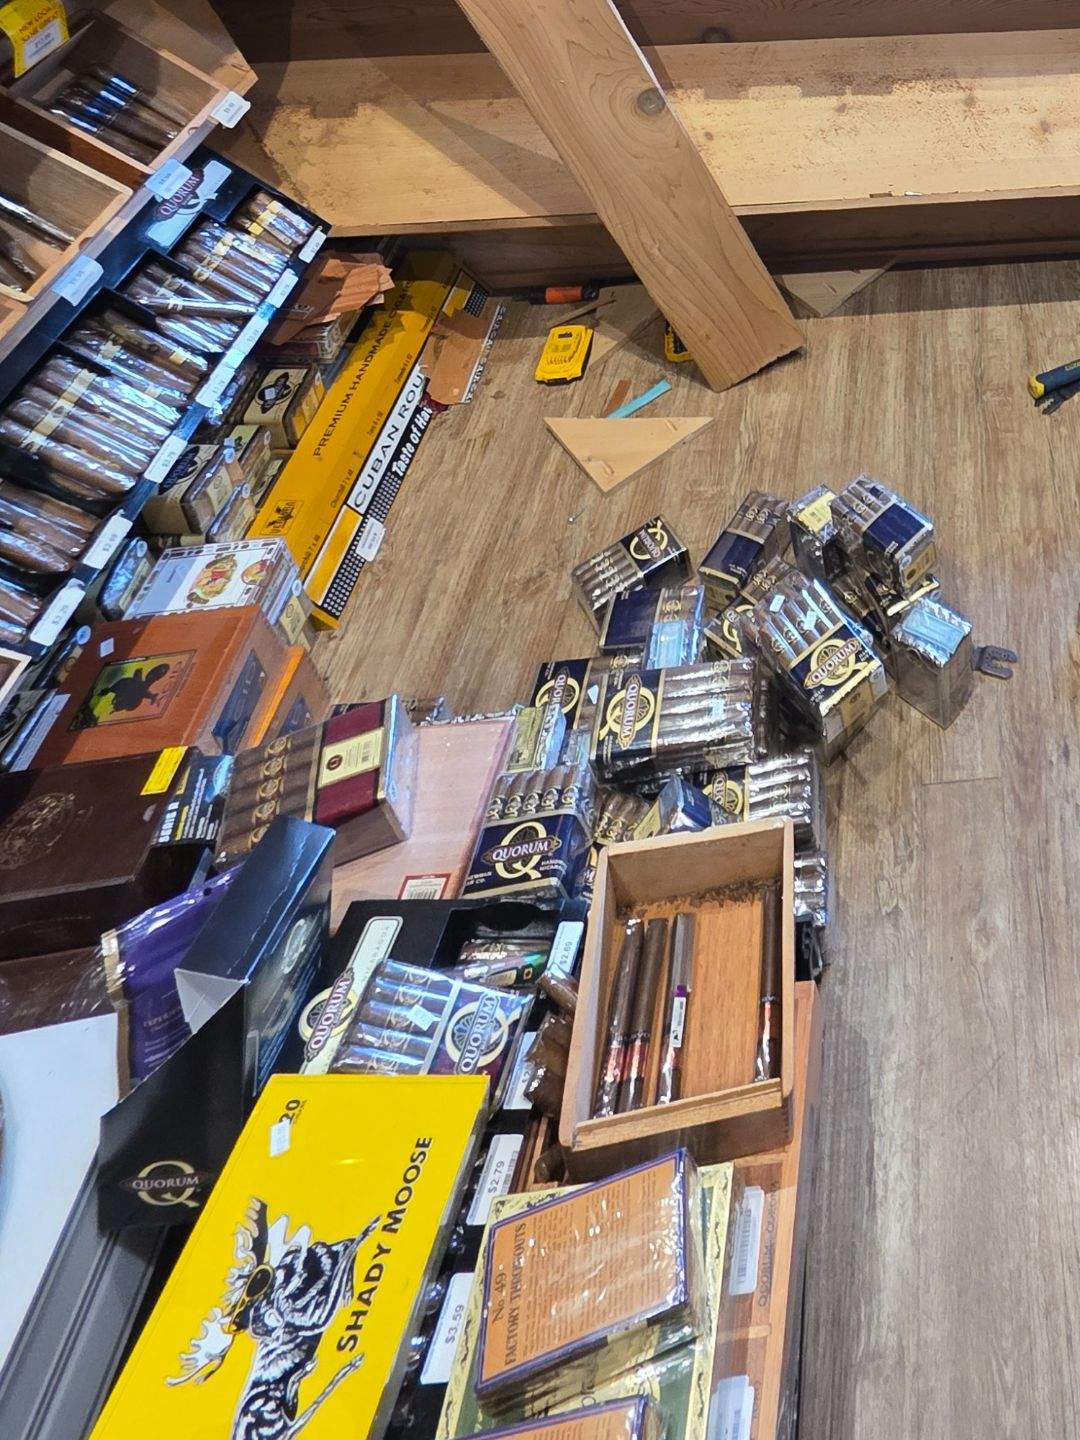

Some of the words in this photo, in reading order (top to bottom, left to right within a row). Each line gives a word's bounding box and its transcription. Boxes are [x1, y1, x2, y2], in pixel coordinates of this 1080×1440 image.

[160, 175, 202, 218] QUORUM
[313, 391, 352, 458] PREMIUM
[349, 317, 396, 392] HANDMADE
[353, 426, 400, 508] CUBAN
[396, 372, 427, 419] ROU
[392, 440, 415, 478] Taste
[811, 640, 858, 684] QUORUM
[620, 682, 641, 740] QUORUM
[492, 840, 550, 862] QUORUM
[310, 978, 351, 1050] QUORUM
[460, 993, 498, 1073] QUORUM
[131, 1173, 200, 1193] QUORUM
[487, 1160, 506, 1195] $2.79
[336, 1242, 392, 1354] SHADY
[380, 1136, 434, 1237] MOOSE
[443, 1303, 466, 1345] $3.59
[503, 1306, 521, 1366] FACTORY
